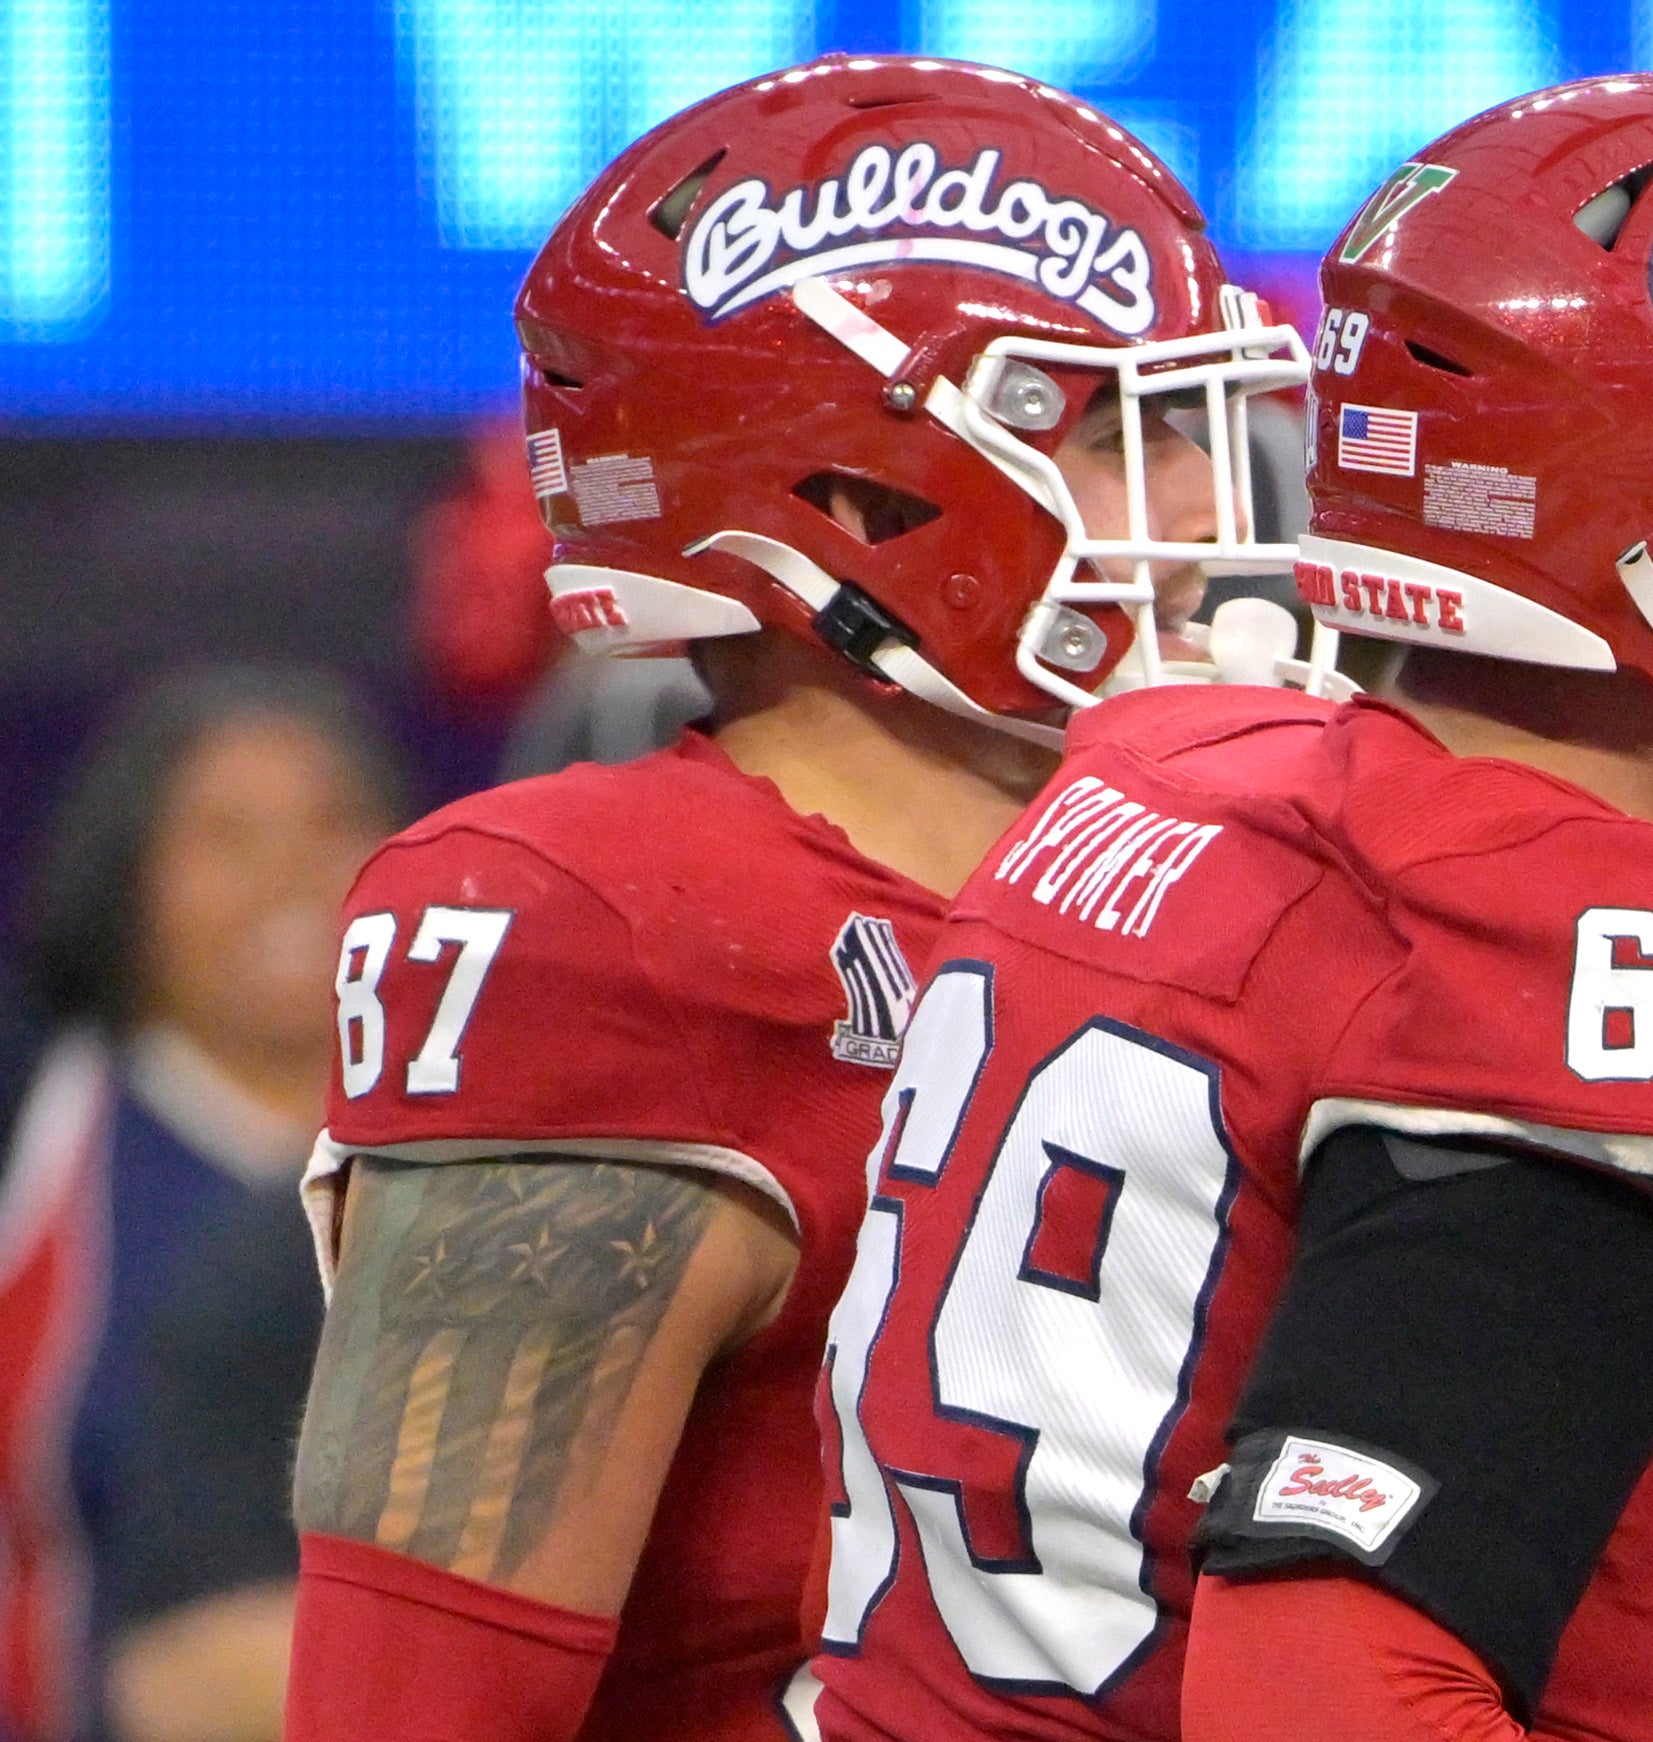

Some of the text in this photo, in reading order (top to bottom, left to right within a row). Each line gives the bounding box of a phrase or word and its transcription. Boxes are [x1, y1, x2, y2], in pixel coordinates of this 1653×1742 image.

[685, 142, 1158, 336] Bulldogs
[1317, 307, 1371, 376] 69
[1451, 460, 1509, 474] WARNING
[1341, 570, 1464, 632] STATE
[994, 776, 1224, 938] SPOMER
[335, 905, 517, 1101] 87
[815, 958, 1242, 1700] 69
